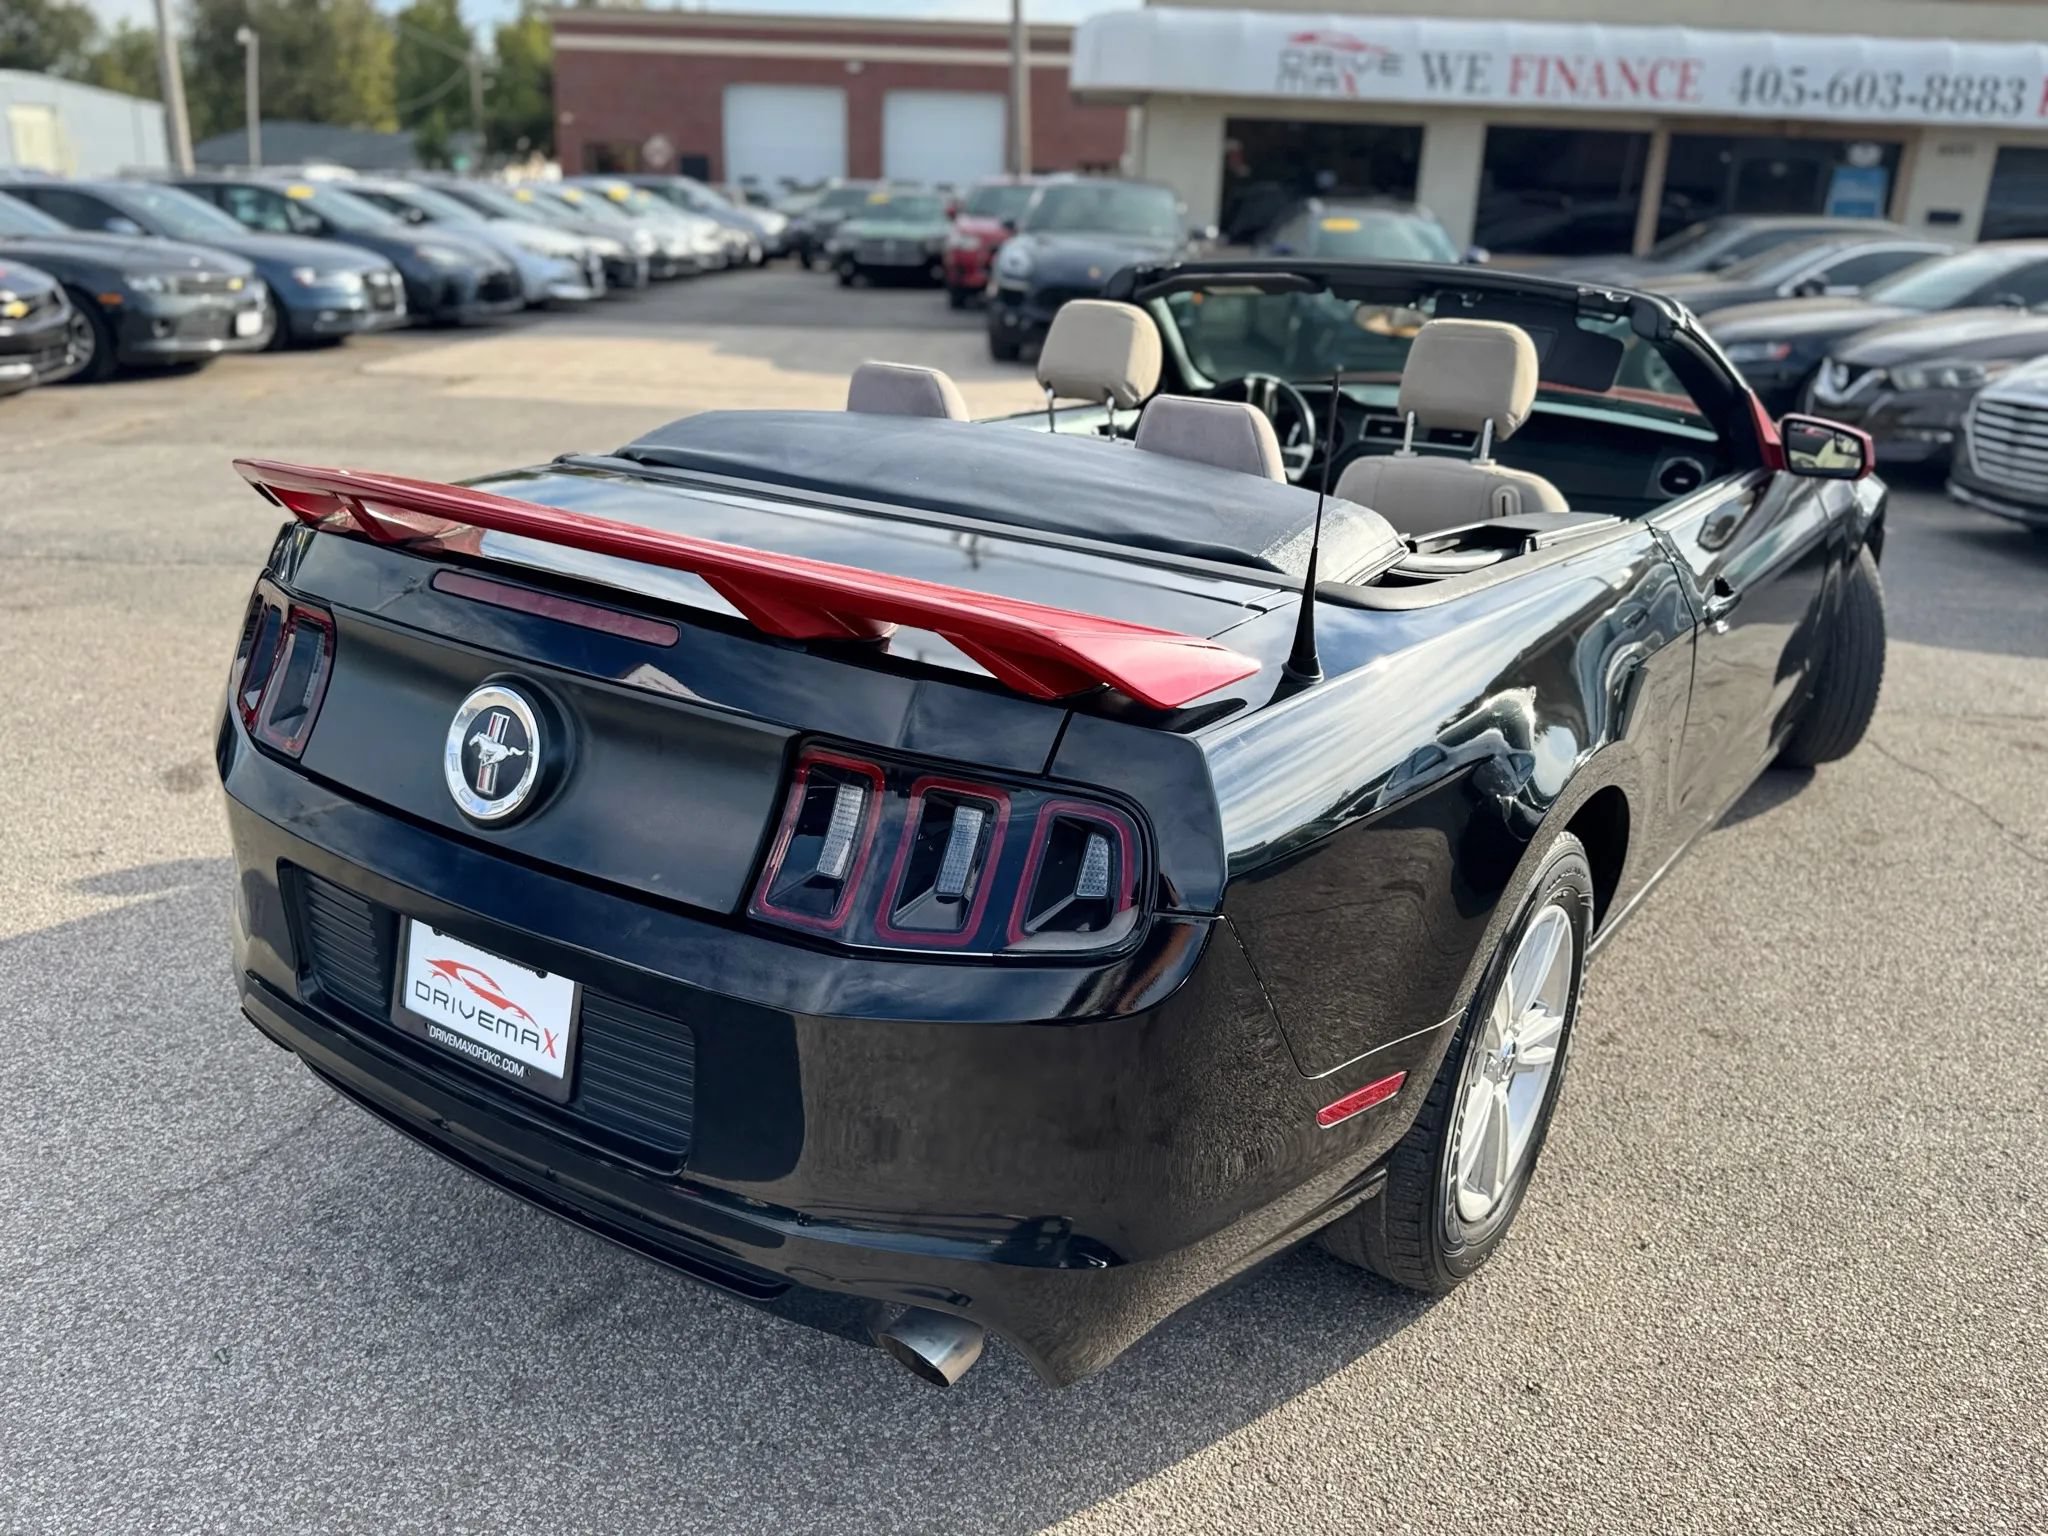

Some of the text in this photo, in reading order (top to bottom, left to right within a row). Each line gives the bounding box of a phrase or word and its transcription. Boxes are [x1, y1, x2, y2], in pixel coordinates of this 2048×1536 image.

[1278, 49, 1404, 79] DRIVE
[1420, 51, 1492, 95] WE
[1508, 52, 1704, 103] FINANCE
[1731, 64, 2027, 117] 405-603-8883
[415, 979, 560, 1059] DRIVEMAX
[428, 1024, 525, 1078] DRIVEMAXOFOKC.COM
